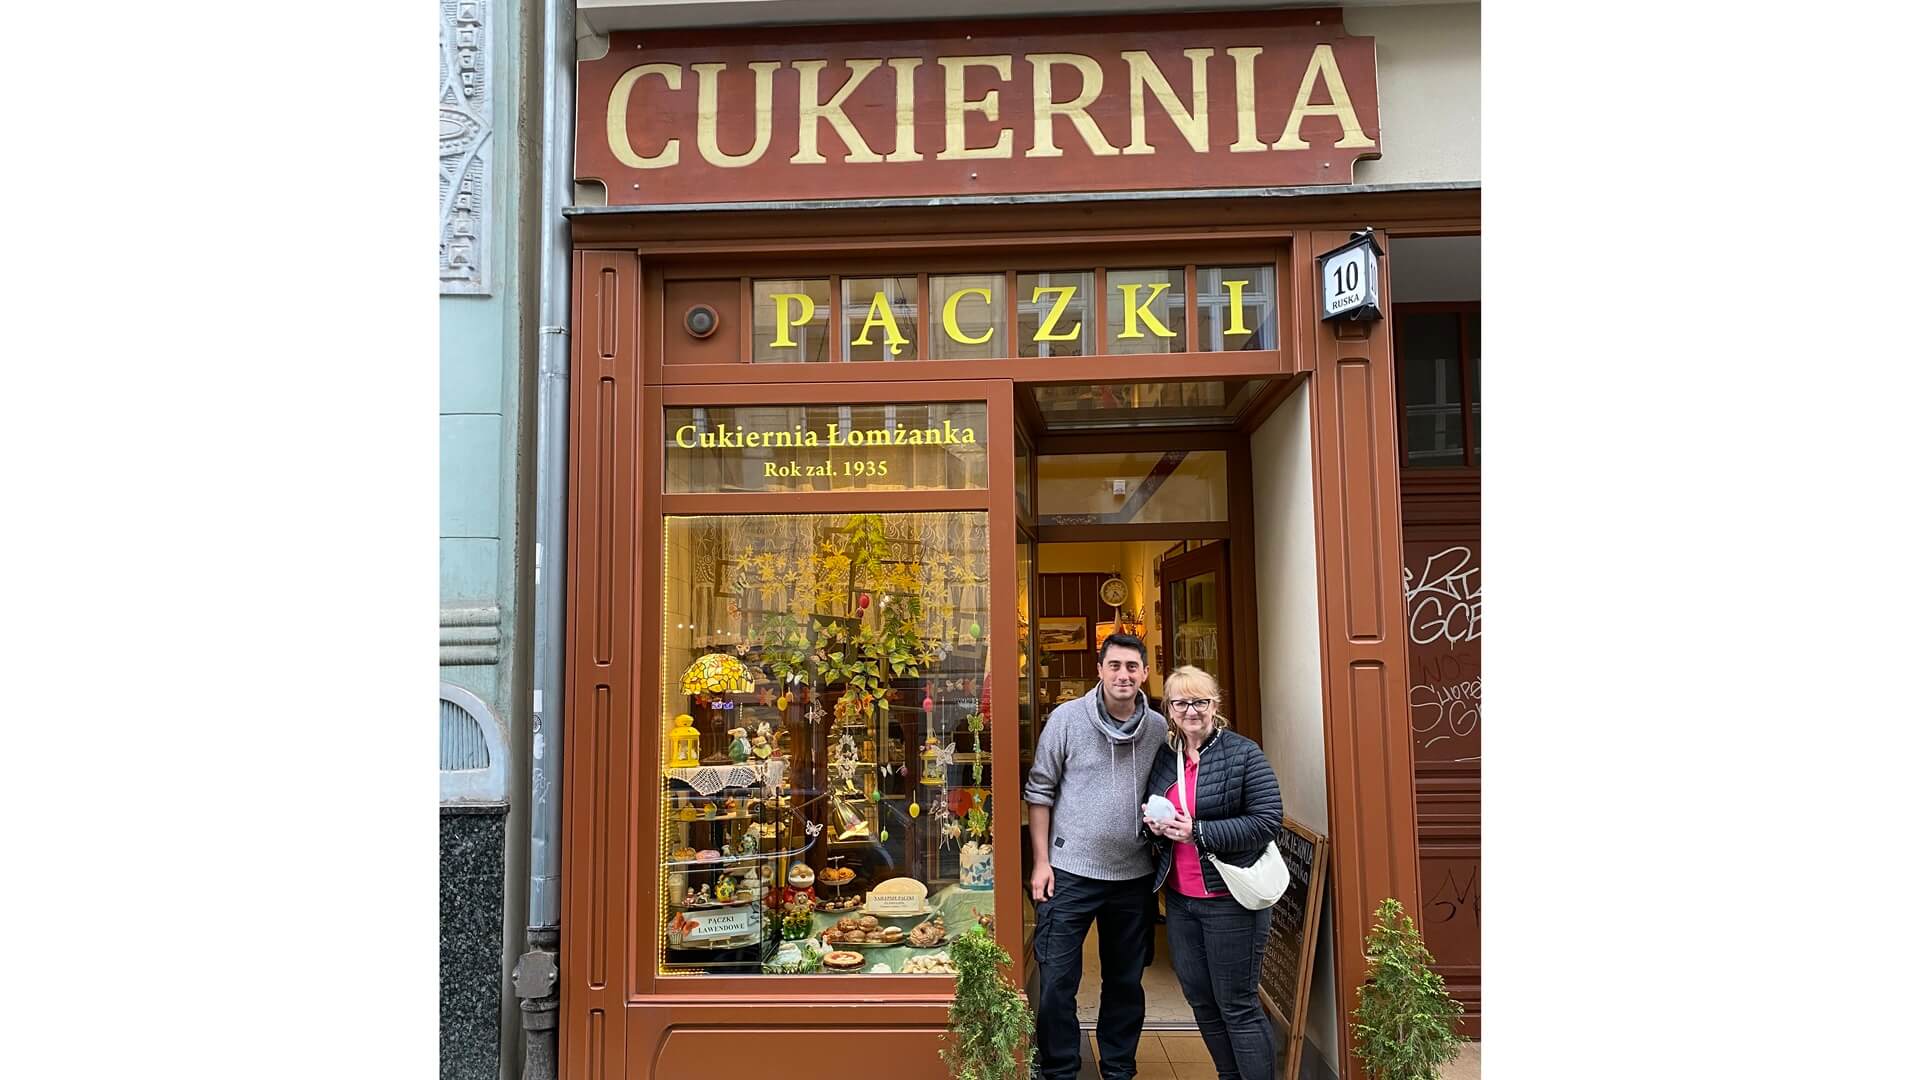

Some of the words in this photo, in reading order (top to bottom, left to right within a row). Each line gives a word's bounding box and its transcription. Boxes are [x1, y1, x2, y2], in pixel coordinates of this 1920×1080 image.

[607, 44, 1376, 169] CUKIERNIA
[1333, 261, 1359, 297] 10
[769, 280, 1252, 355] PĄCZKI
[1332, 293, 1360, 311] RUSKA
[675, 423, 819, 449] Cukiernia
[826, 420, 977, 447] Łomżanka
[764, 460, 801, 477] Rok
[806, 460, 837, 477] zał.
[843, 460, 888, 477] 1935
